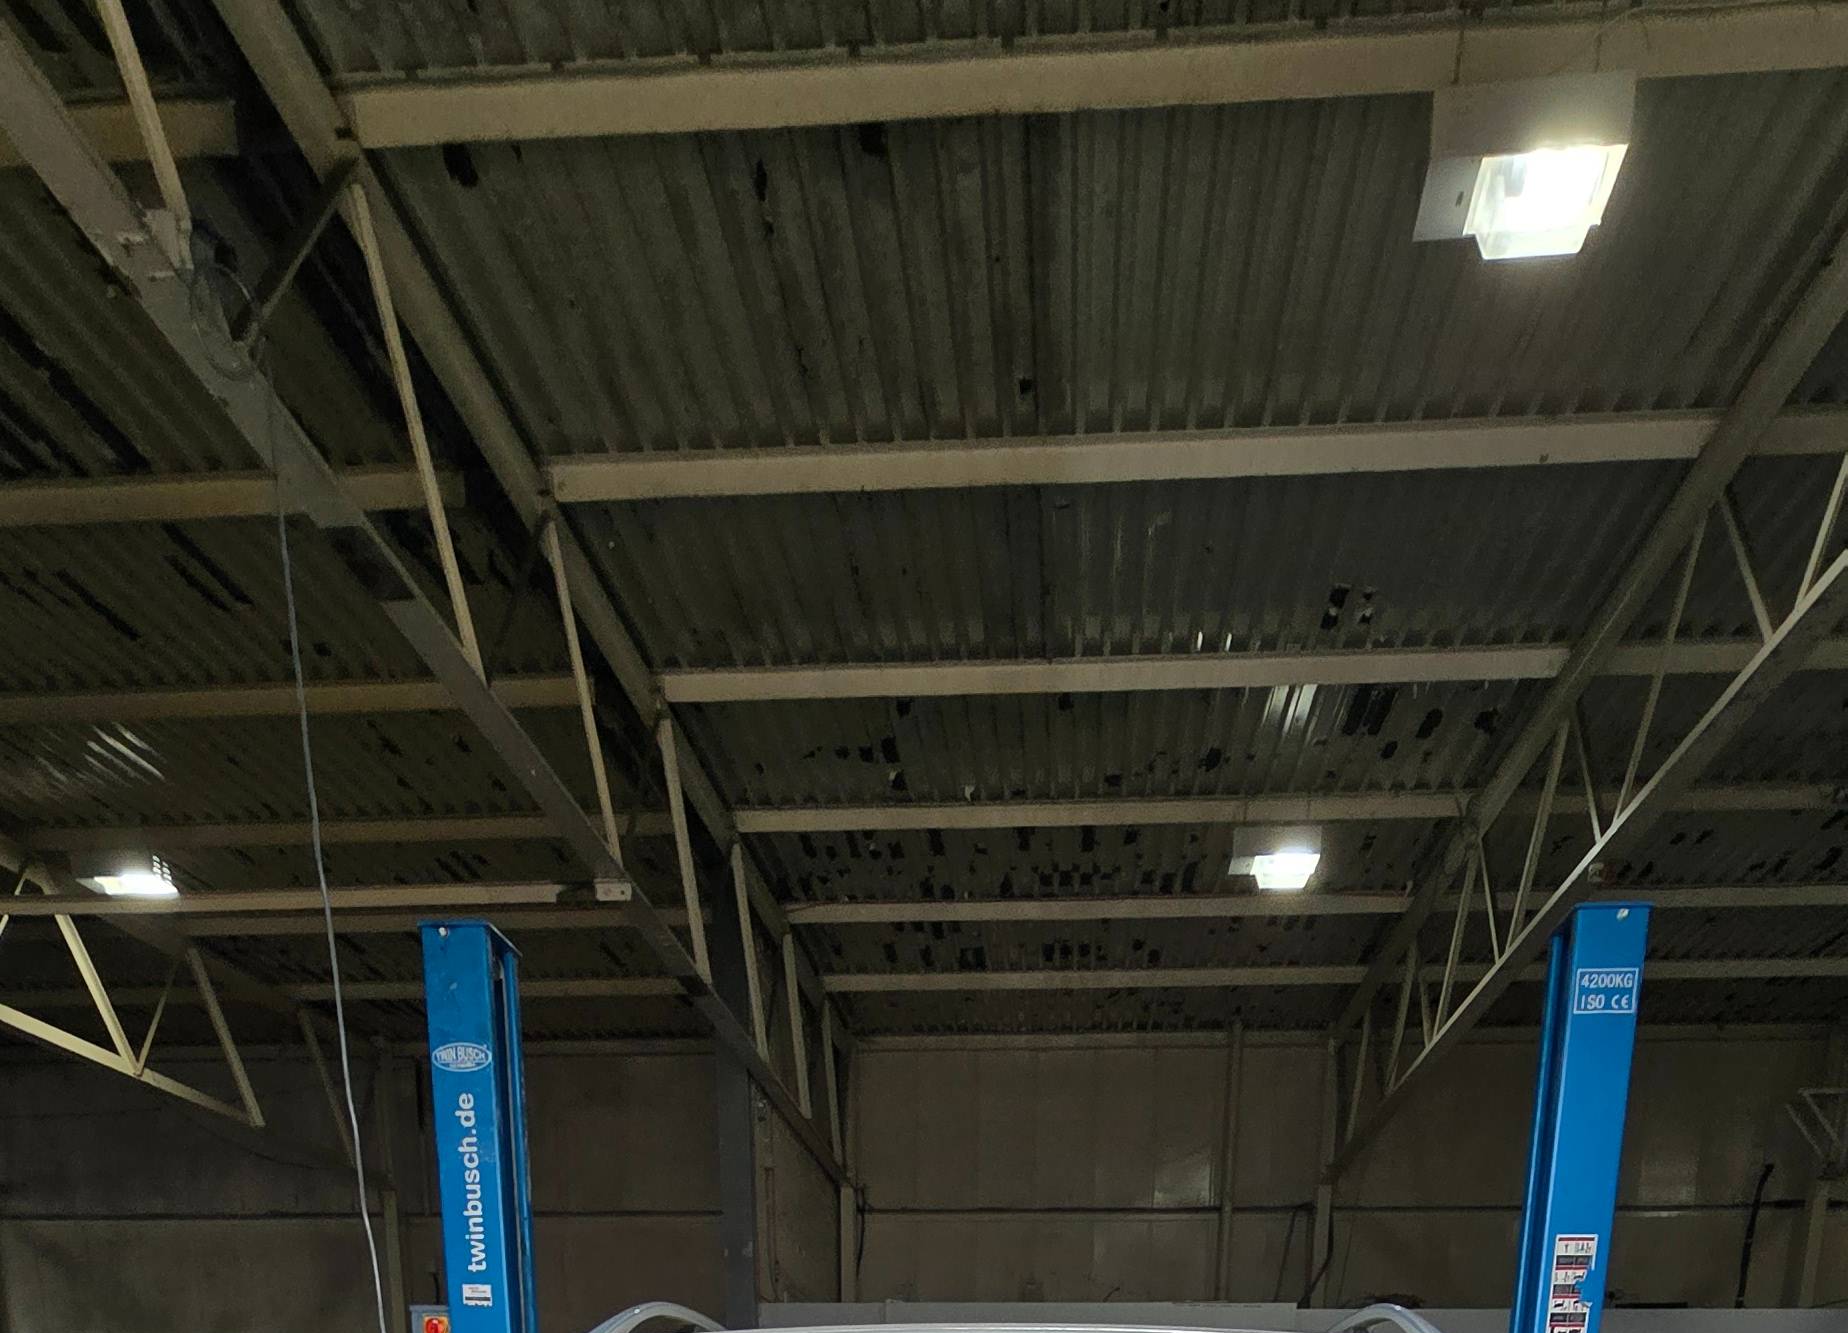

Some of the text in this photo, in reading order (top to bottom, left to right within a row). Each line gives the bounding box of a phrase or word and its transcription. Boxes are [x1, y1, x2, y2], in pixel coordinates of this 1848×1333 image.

[1581, 973, 1633, 988] 4200KG
[1581, 994, 1605, 1009] ISO
[455, 1092, 487, 1272] twinbusch.de
